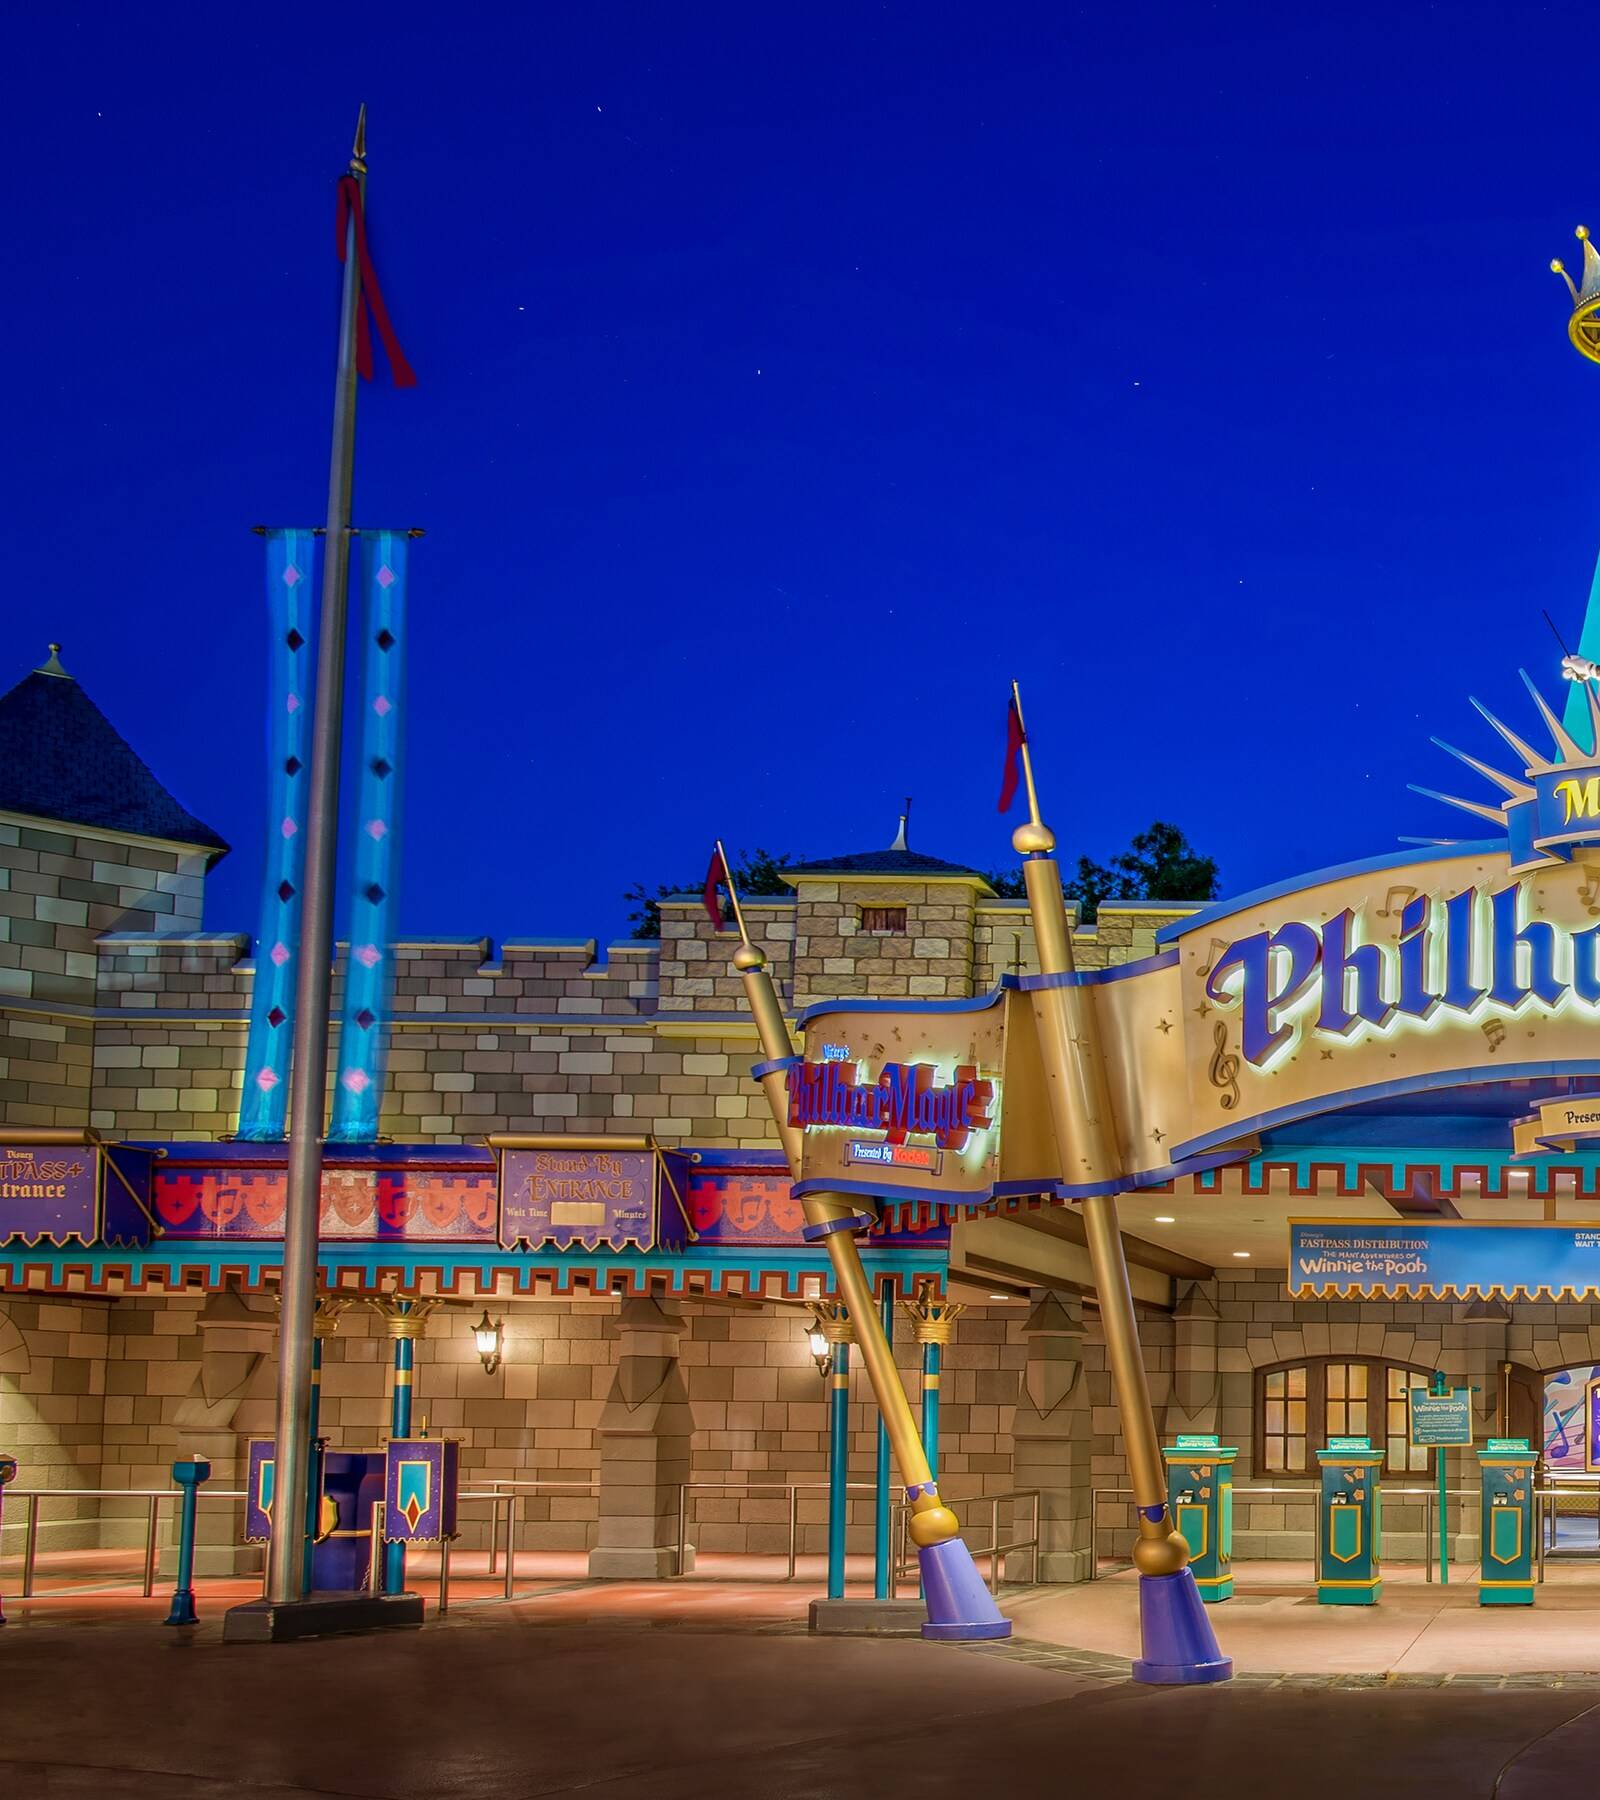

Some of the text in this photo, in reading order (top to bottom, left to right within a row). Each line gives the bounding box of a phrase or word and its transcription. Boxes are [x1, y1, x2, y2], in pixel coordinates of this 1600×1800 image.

[893, 1148, 929, 1165] Kodak
[506, 1207, 548, 1217] Wait Time
[612, 1208, 647, 1219] Minutes
[1353, 1239, 1430, 1250] DISTRIBUTION
[1574, 1240, 1595, 1248] WAIT
[1299, 1257, 1428, 1276] Winnie the Pooh
